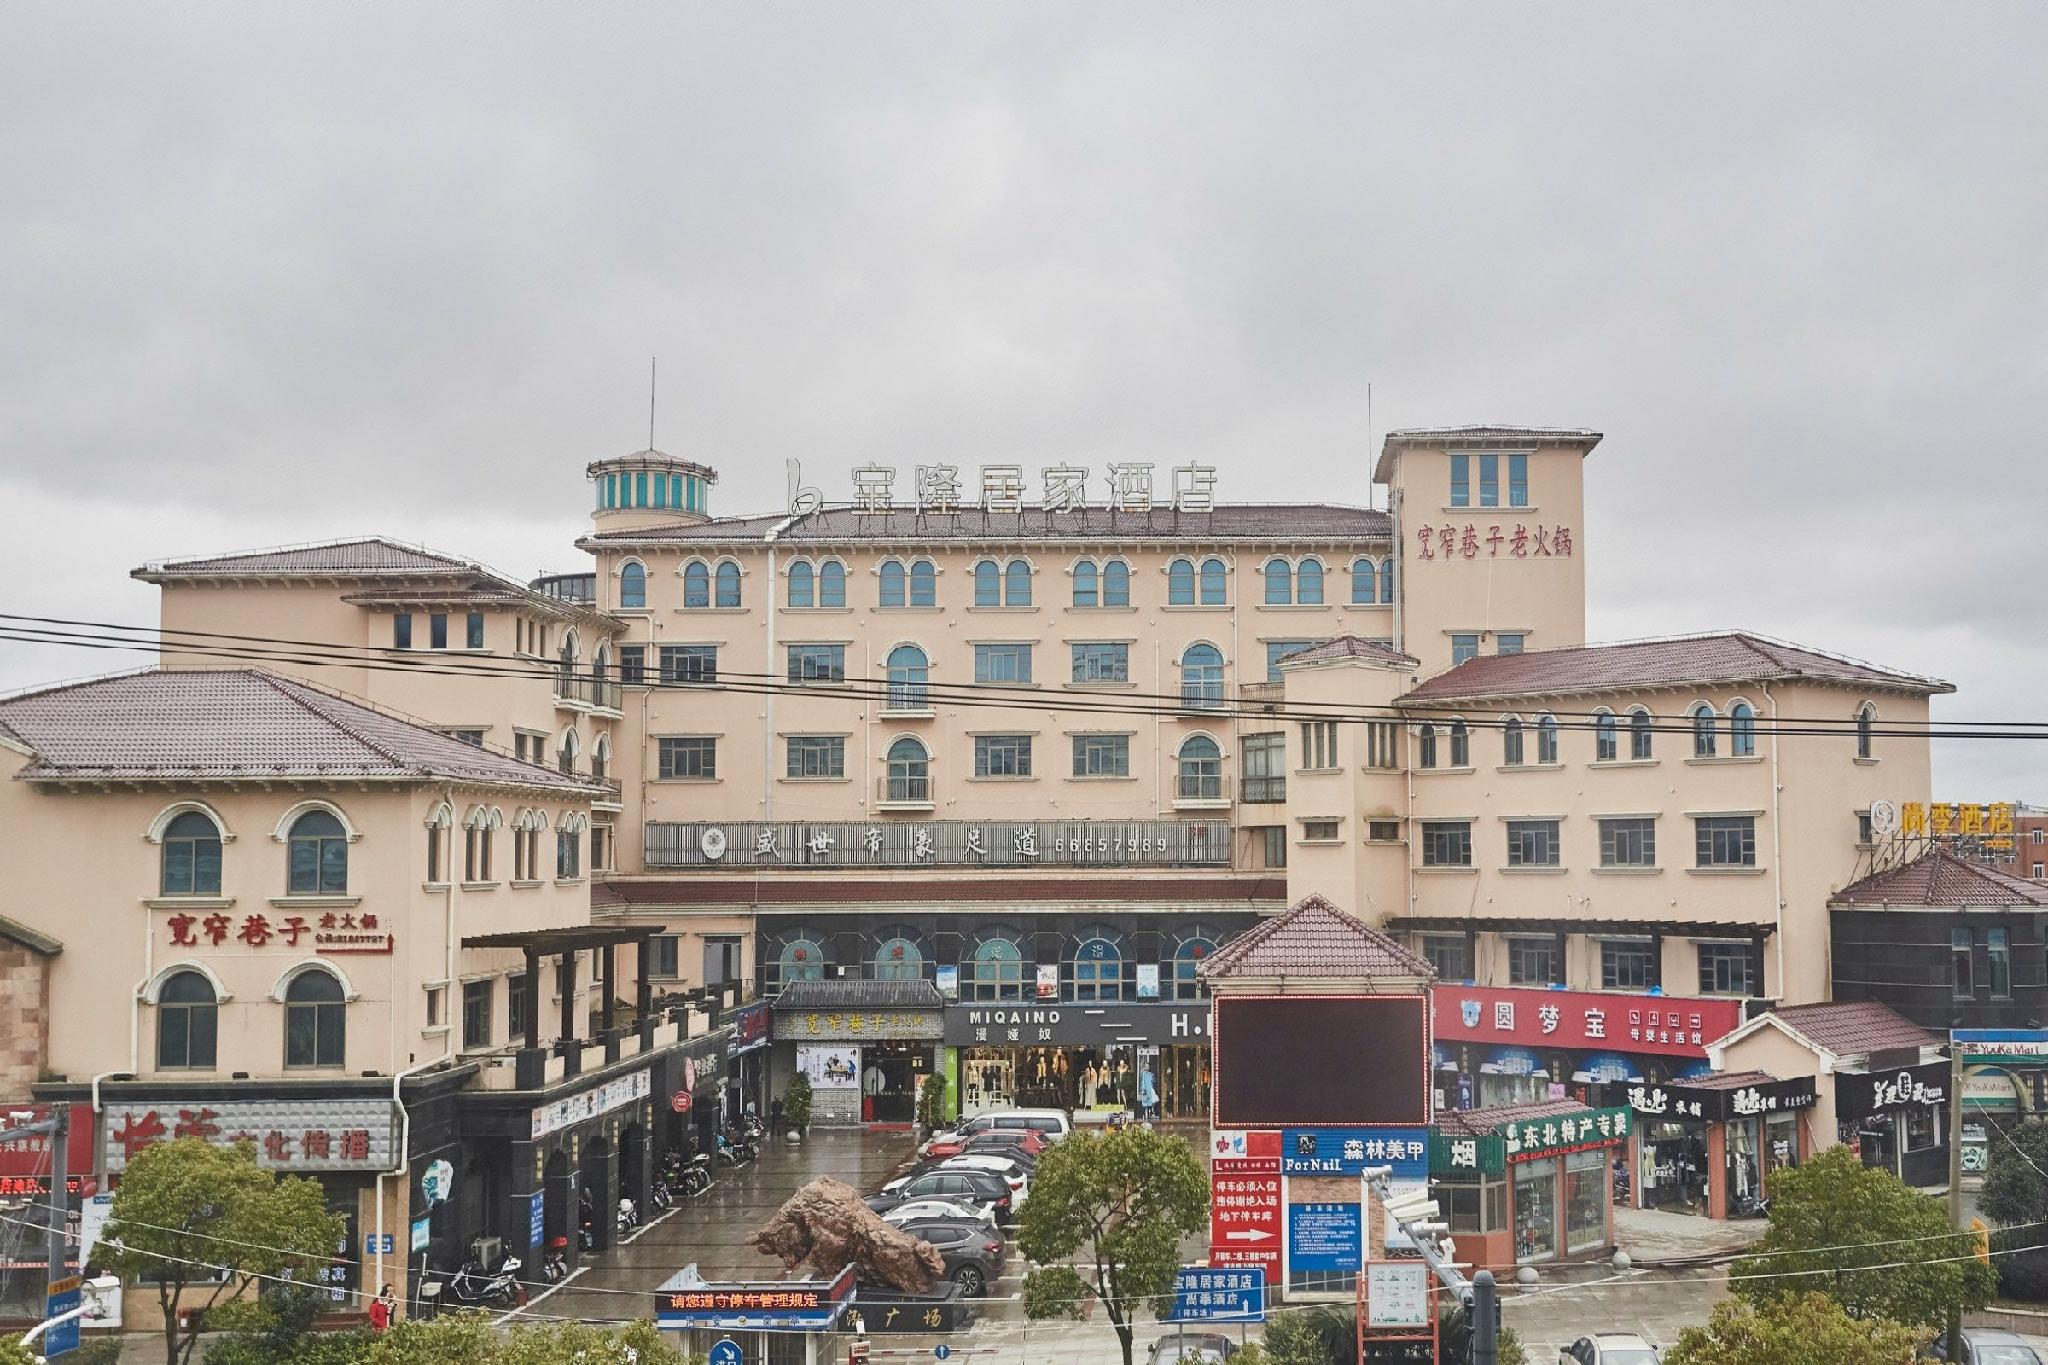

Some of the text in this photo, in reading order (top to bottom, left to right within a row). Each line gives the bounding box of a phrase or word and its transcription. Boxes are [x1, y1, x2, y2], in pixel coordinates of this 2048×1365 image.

[851, 461, 1217, 515] 宝隆居家酒店
[1418, 524, 1572, 559] 宽窄巷子老火锅
[1903, 802, 2013, 834] 尚季酒店
[755, 827, 1166, 857] 盛世帝豪足道 66857989
[167, 912, 377, 946] 宽窄巷子 老火锅
[806, 1013, 885, 1034] 宽窄巷子
[970, 1011, 1060, 1025] MIQAINO
[1494, 1001, 1606, 1038] 圆梦宝
[1630, 1028, 1701, 1045] 母婴生活馆
[1524, 1112, 1627, 1149] 东北特产专卖
[1344, 1139, 1424, 1161] 森林美甲
[1451, 1140, 1477, 1168] 烟
[1216, 1181, 1277, 1192] 停车必须入位
[1219, 1211, 1273, 1222] 地下停车库
[1172, 1274, 1252, 1290] 宝隆居家酒店
[671, 1293, 818, 1308] 请您遵守停车管理规定
